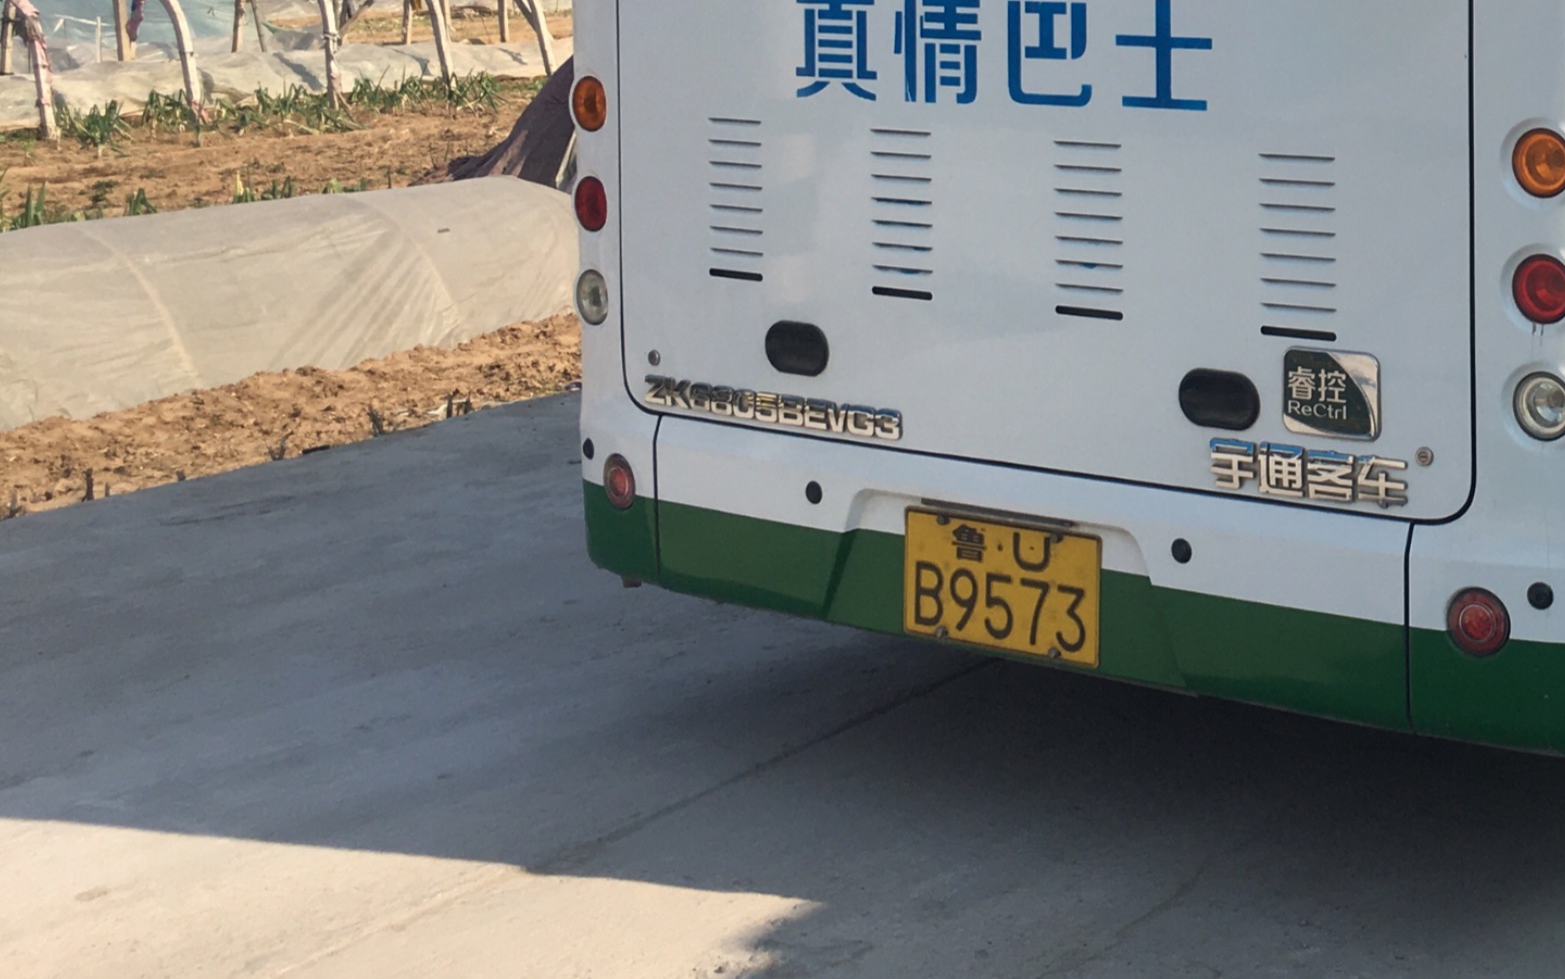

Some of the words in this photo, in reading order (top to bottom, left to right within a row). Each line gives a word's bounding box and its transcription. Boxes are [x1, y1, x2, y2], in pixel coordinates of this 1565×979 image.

[1288, 366, 1347, 403] 睿控
[1288, 400, 1347, 420] ReCtrl
[1210, 437, 1408, 509] 宇通客车
[914, 560, 1086, 652] B9573
